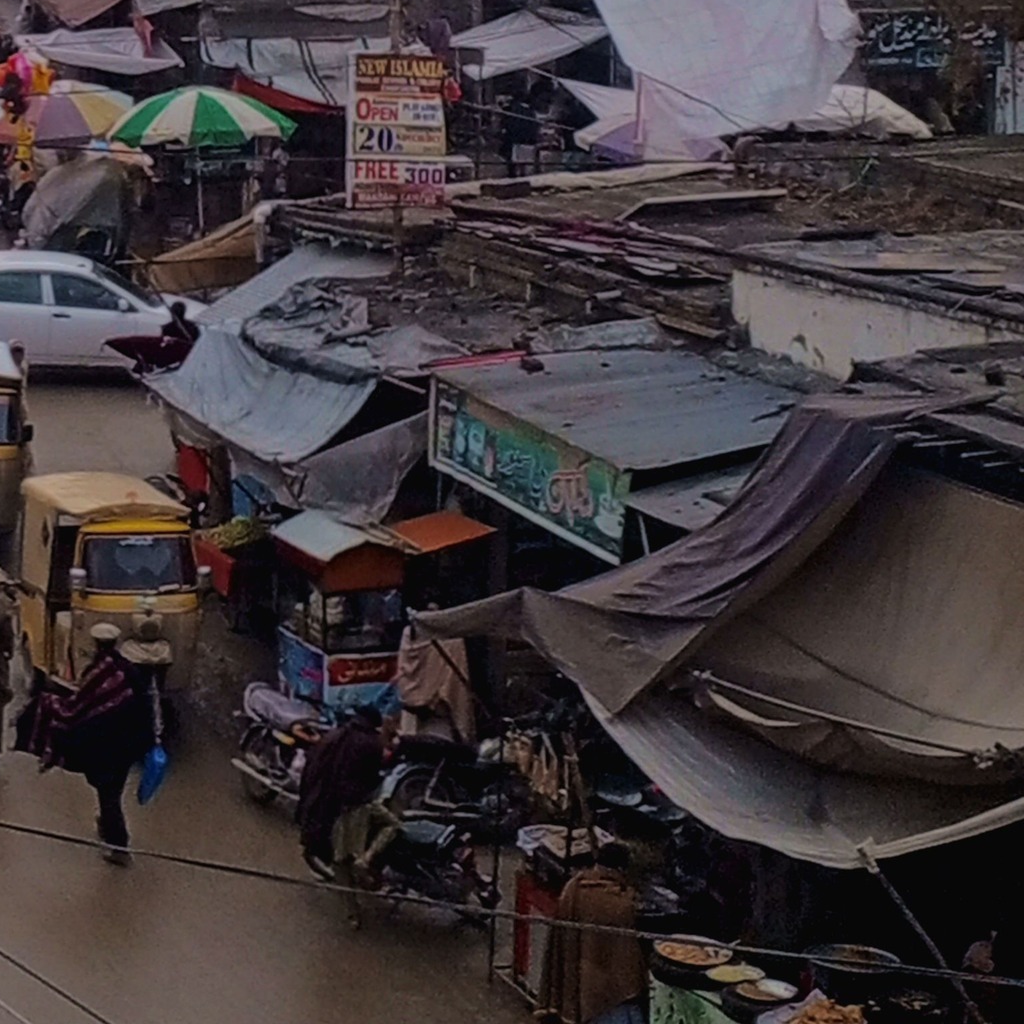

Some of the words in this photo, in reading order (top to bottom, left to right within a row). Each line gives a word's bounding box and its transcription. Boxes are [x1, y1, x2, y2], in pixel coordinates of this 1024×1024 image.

[358, 59, 387, 76] NEW
[390, 59, 444, 77] ISLAMIA
[357, 98, 398, 121] OPEN
[356, 160, 399, 180] FREE
[405, 168, 443, 184] 300
